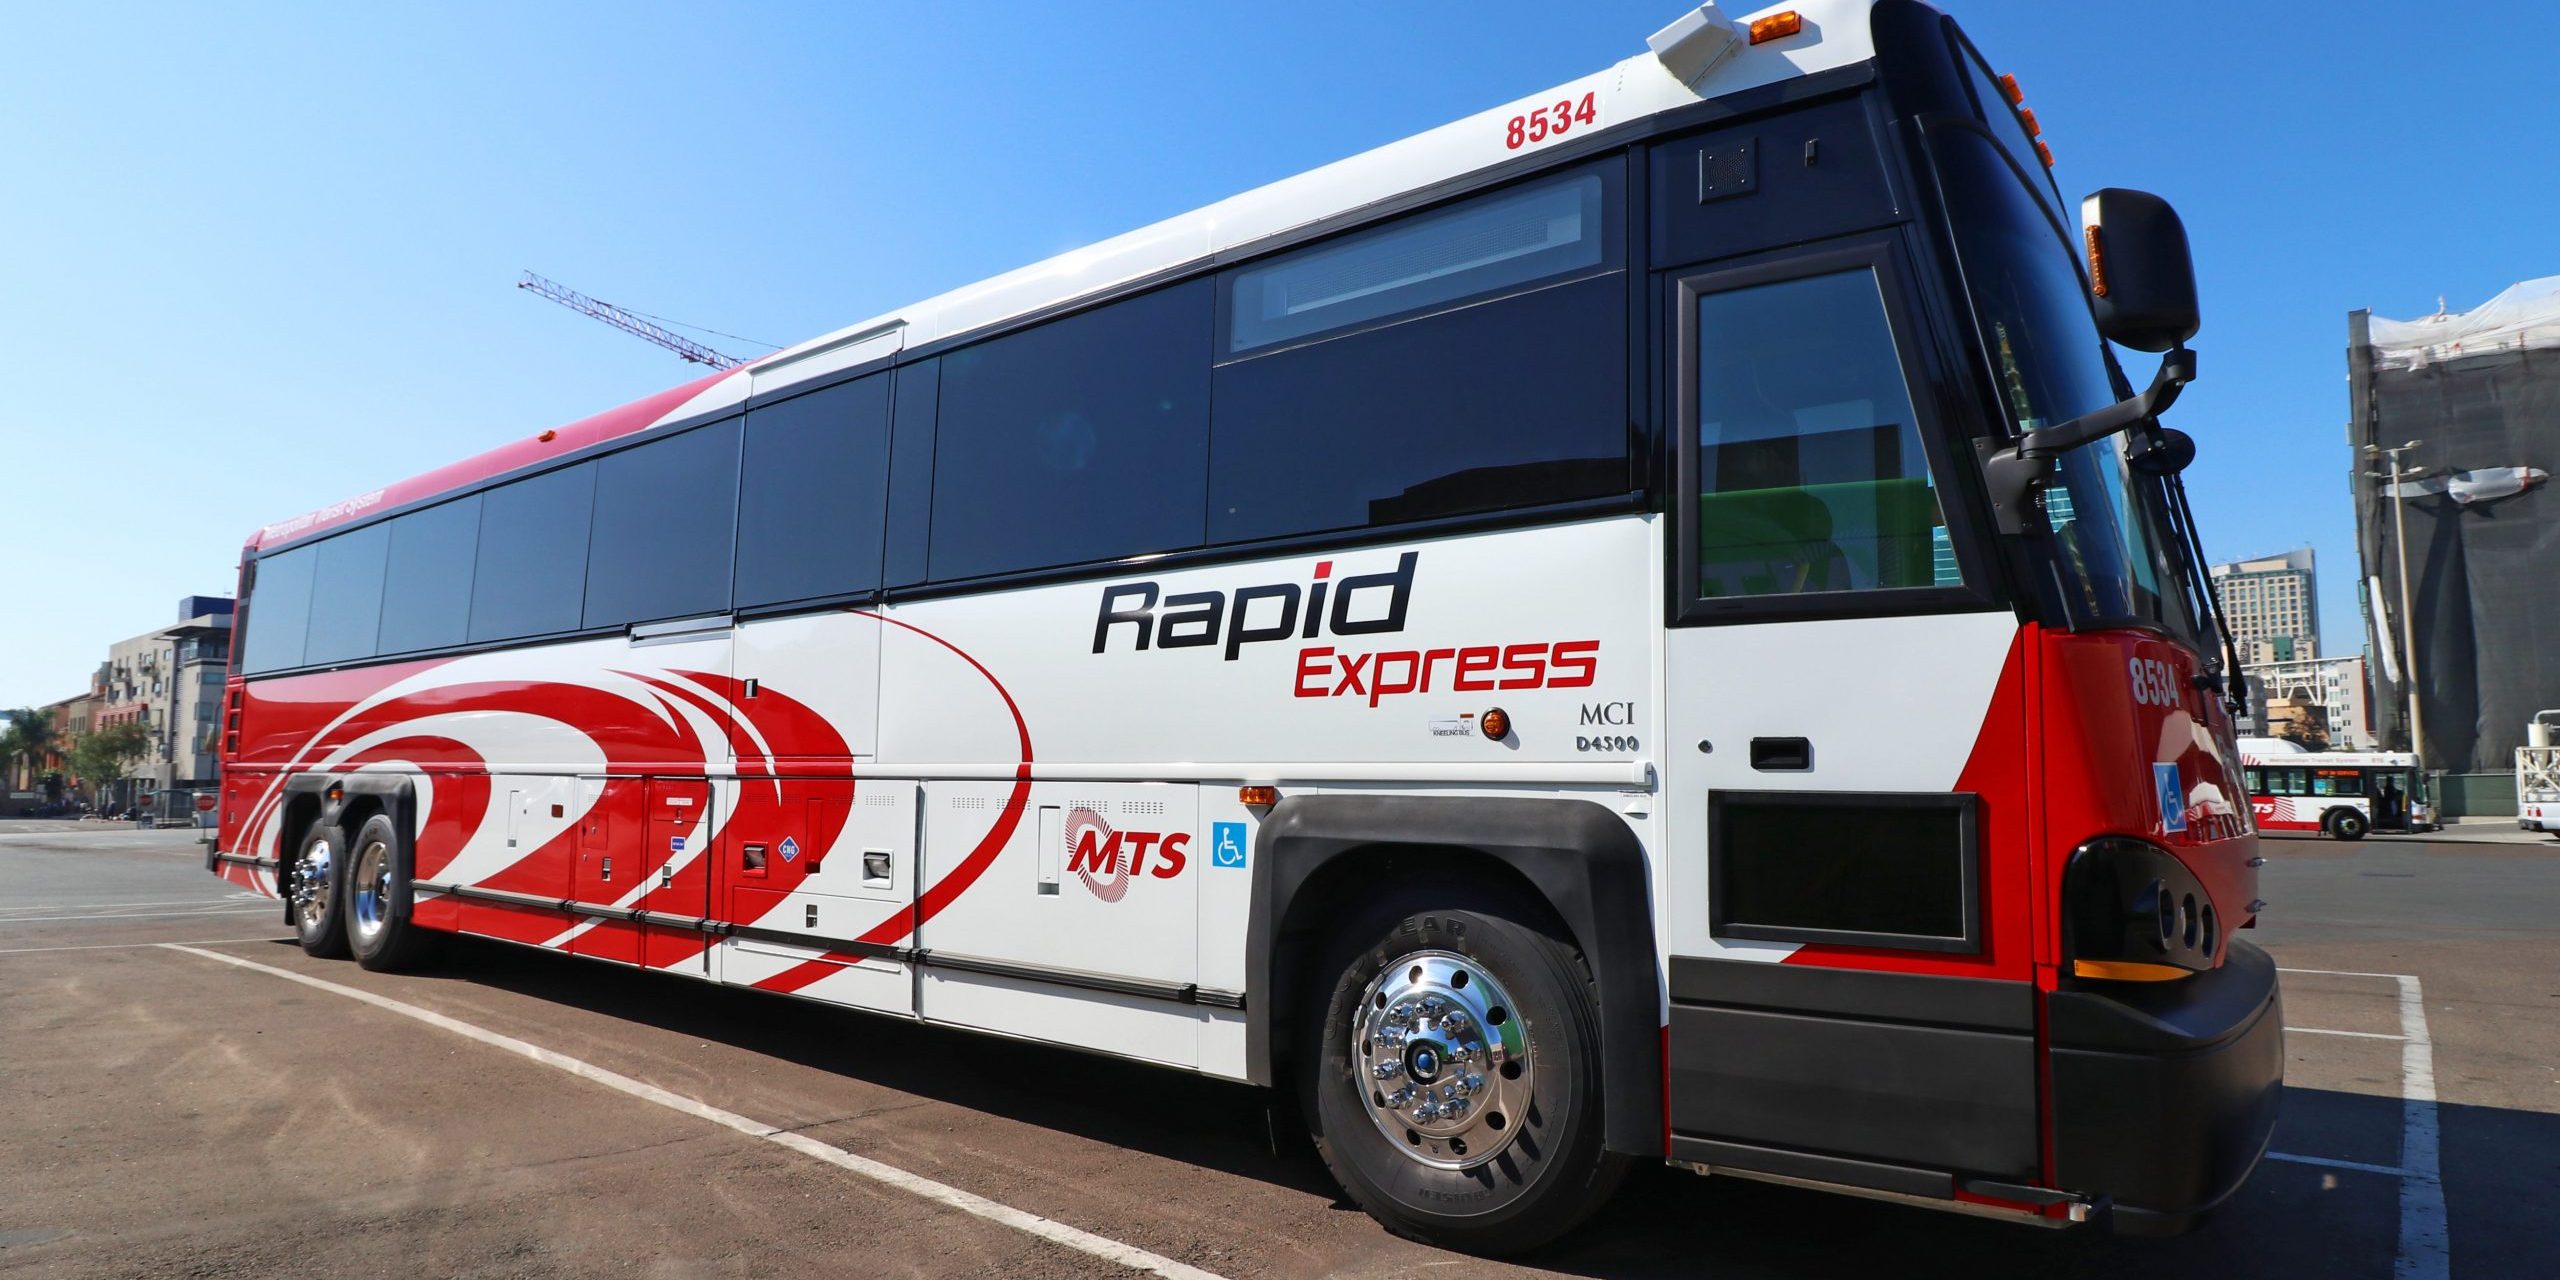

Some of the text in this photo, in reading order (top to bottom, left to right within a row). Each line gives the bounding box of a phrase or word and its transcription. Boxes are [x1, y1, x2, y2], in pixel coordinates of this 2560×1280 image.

[1506, 91, 1596, 150] 8534
[1092, 551, 1419, 661] Rapid
[1294, 640, 1600, 708] Express
[2129, 656, 2180, 707] 8534
[1580, 702, 1635, 725] MCI
[1433, 728, 1458, 737] KNEELING
[1576, 735, 1640, 752] D4500
[2251, 803, 2274, 814] TS
[782, 844, 796, 855] CNG
[1066, 830, 1191, 879] MTS
